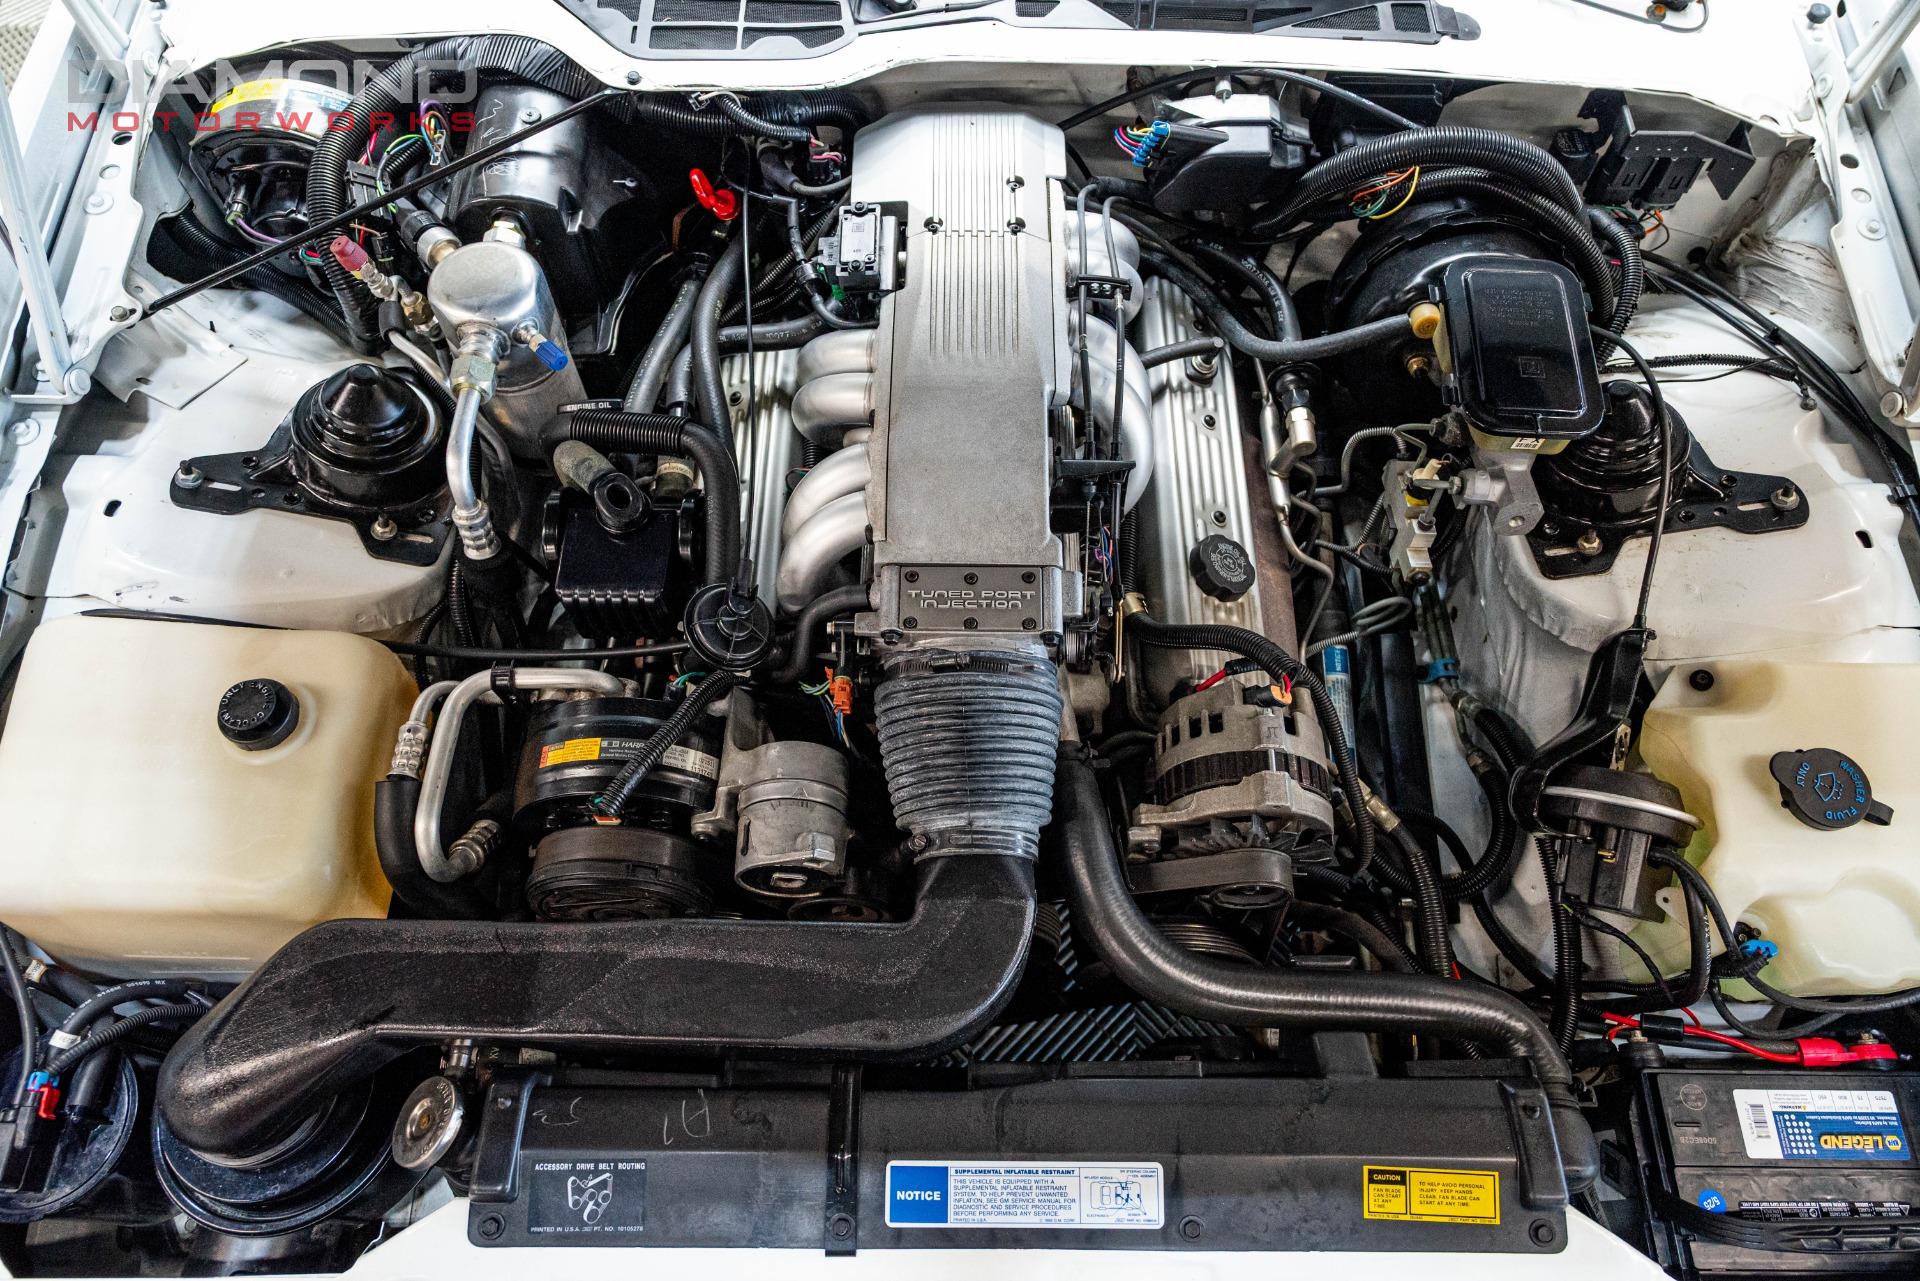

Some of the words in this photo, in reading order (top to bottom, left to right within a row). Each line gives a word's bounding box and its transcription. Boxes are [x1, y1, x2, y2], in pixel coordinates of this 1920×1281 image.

[566, 402, 596, 412] ENGINE
[907, 590, 974, 598] TUNED
[981, 590, 1036, 600] PORT
[920, 600, 1022, 610] INJECTION
[220, 682, 245, 705] ONLY
[1796, 762, 1810, 787] ONLY
[1840, 760, 1866, 804] WASHER
[1825, 806, 1858, 820] FLUID
[1820, 1135, 1884, 1149] LEGEND
[896, 1190, 941, 1201] NOTICE
